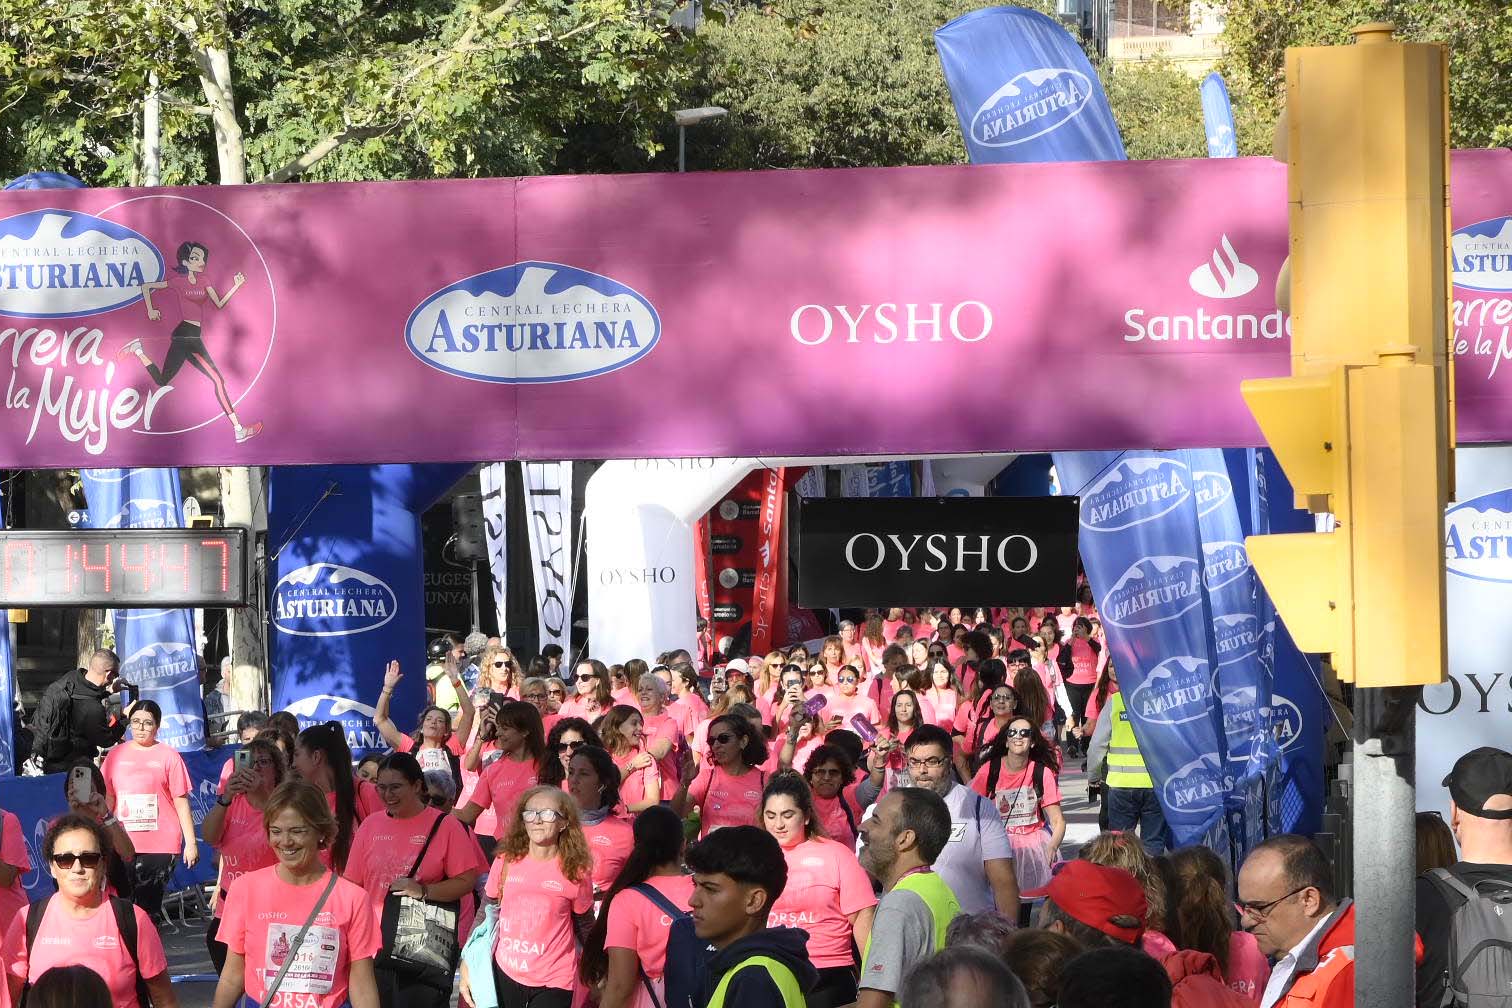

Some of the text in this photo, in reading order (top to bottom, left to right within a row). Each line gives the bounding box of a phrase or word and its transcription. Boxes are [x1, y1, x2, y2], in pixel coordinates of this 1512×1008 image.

[465, 302, 633, 317] CENTRAL LECHERA
[790, 301, 993, 345] OYSHO
[424, 310, 641, 354] ASTURIANA
[6, 367, 30, 409] la
[25, 362, 175, 455] Mujer
[845, 533, 1038, 573] OYSHO
[600, 566, 676, 585] OYSHO
[277, 593, 388, 620] ASTURIANA
[287, 588, 383, 597] CENTRAL LECHERA
